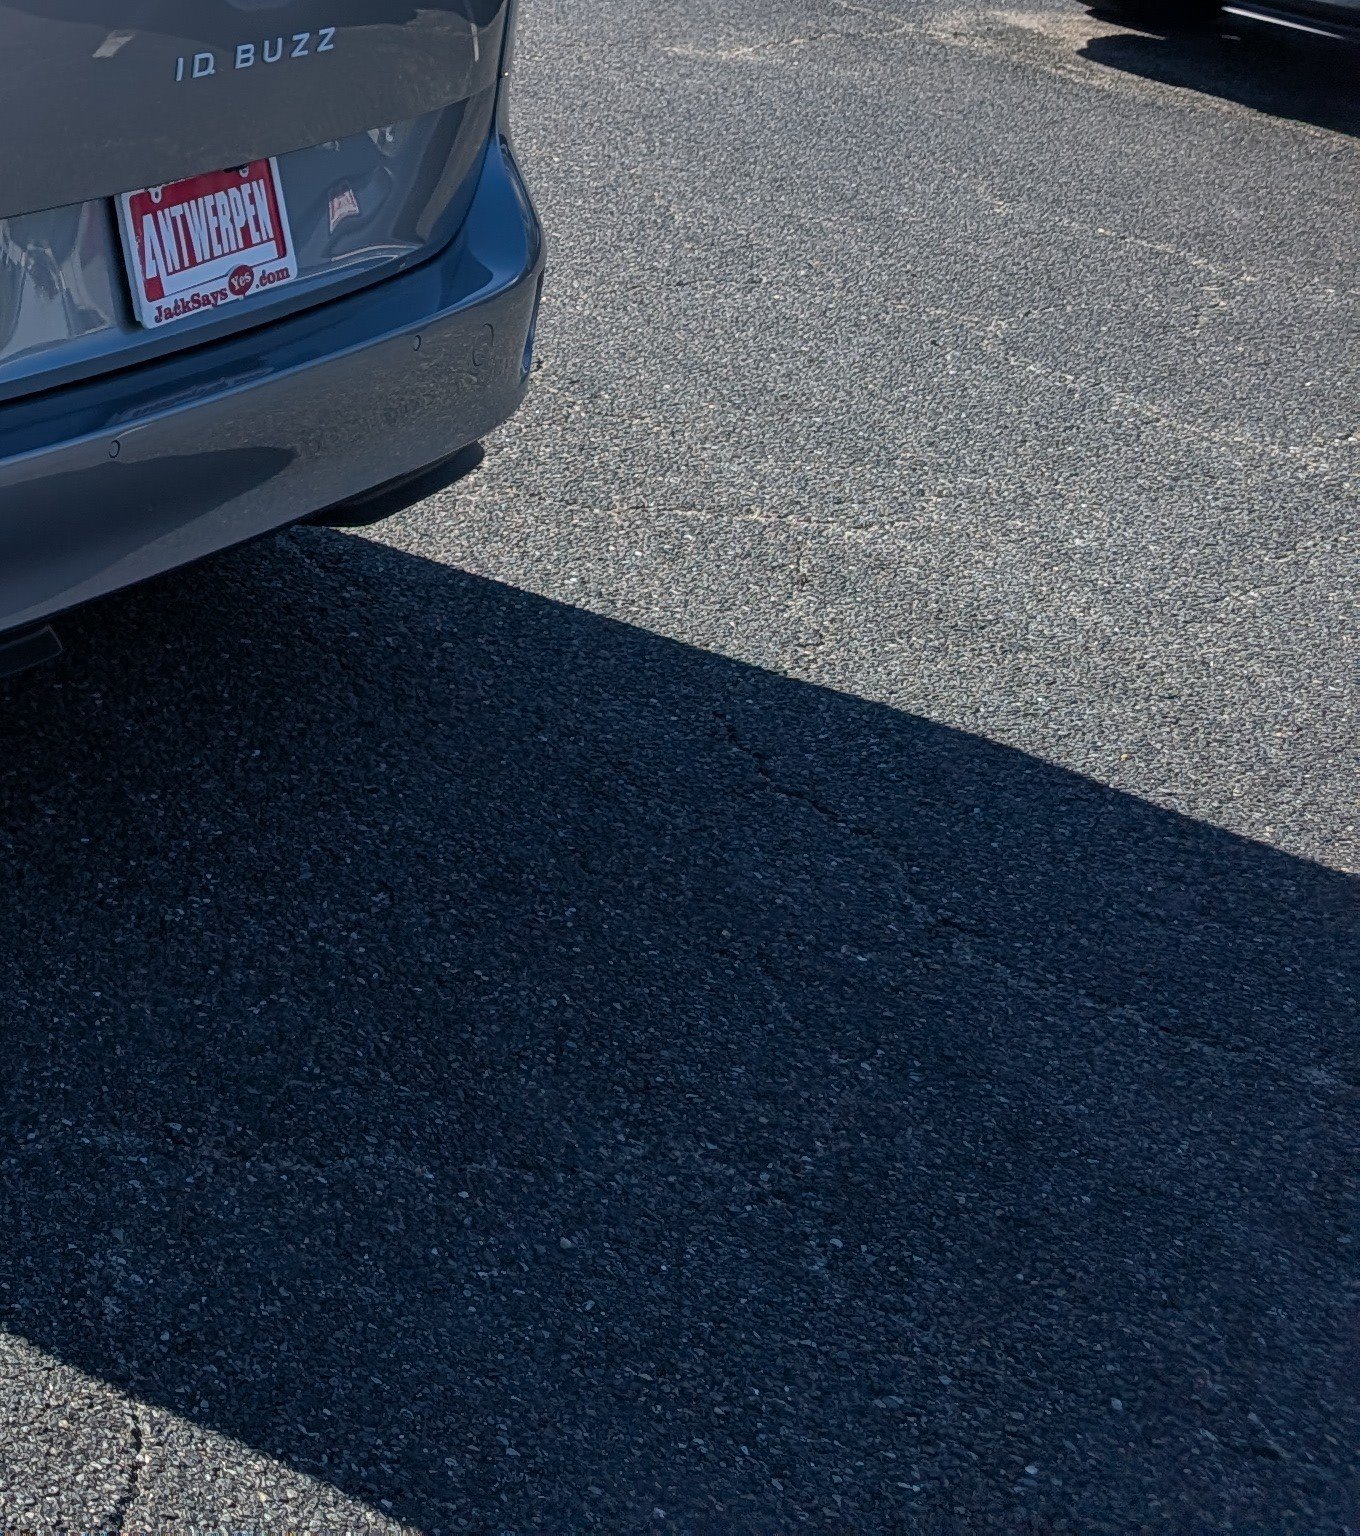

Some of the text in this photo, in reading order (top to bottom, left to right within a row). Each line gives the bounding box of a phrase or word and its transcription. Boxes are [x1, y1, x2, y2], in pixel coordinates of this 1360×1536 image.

[234, 26, 337, 70] BUZZ
[142, 178, 275, 280] ANTWERPEN
[153, 286, 229, 324] JackSays
[230, 271, 252, 291] Yes
